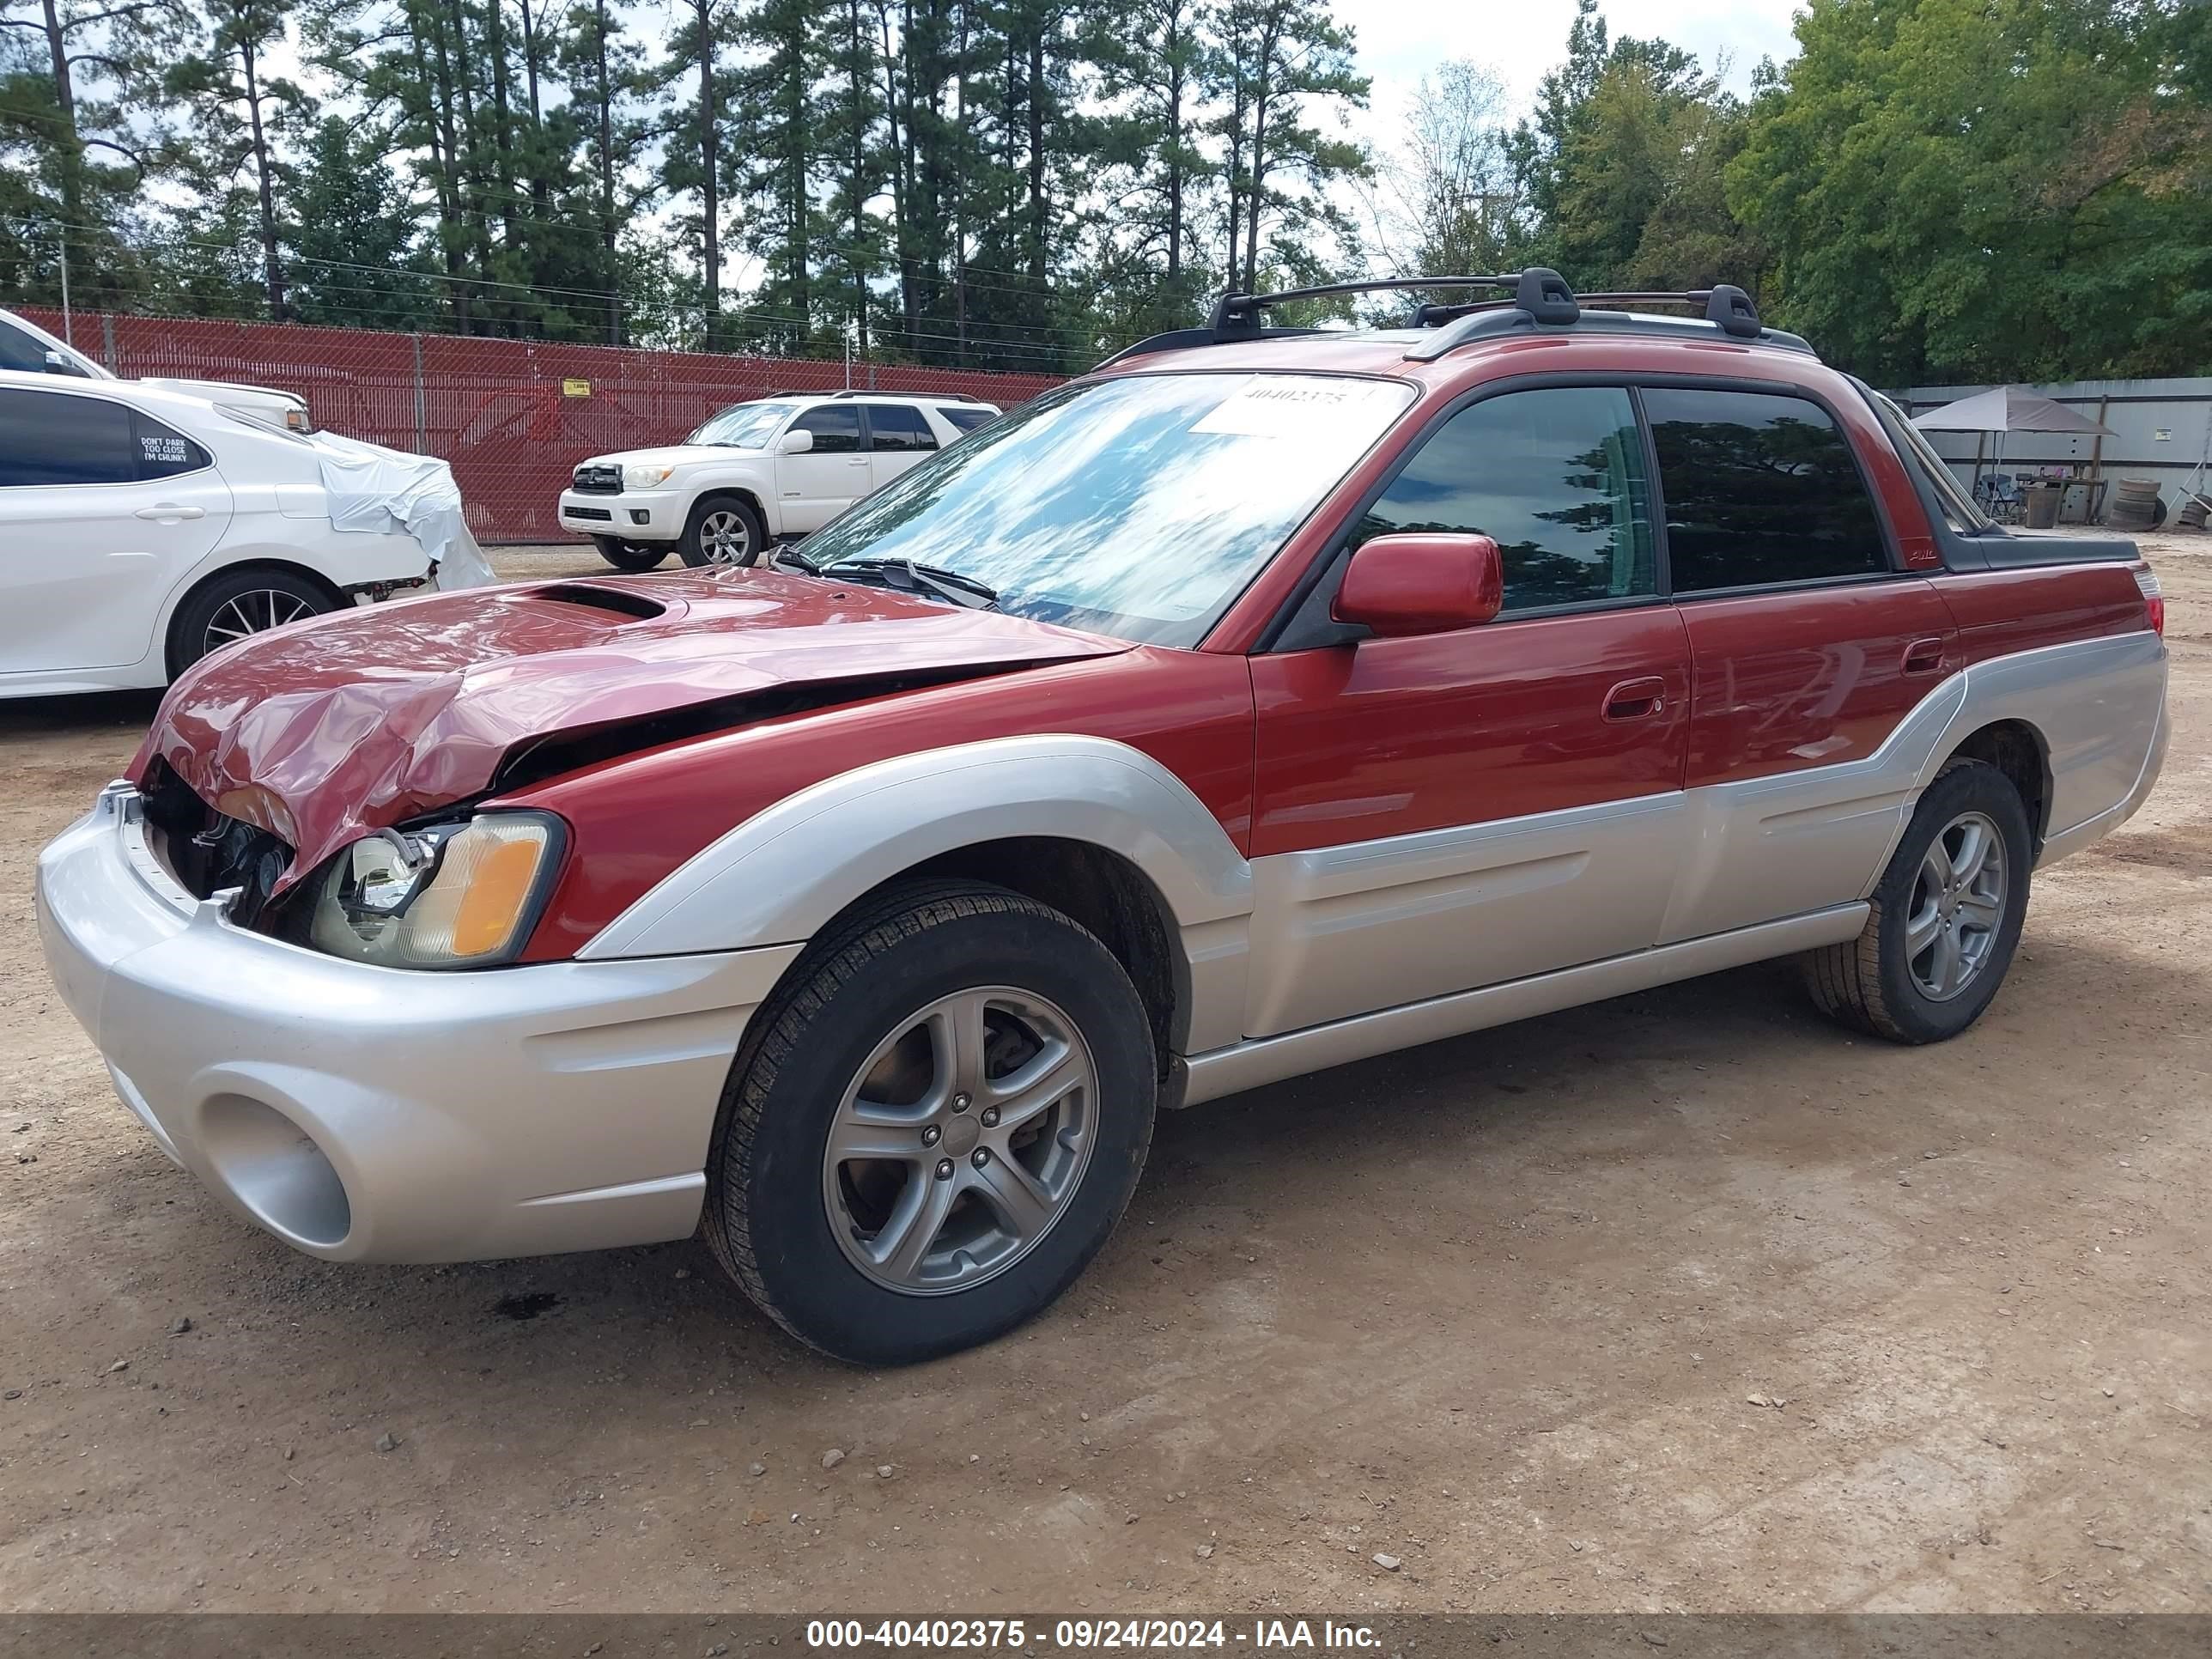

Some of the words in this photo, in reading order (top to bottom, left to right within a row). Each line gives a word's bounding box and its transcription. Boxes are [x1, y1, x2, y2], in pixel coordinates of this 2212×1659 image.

[141, 437, 163, 446] DON'T
[165, 438, 185, 447] PARK
[163, 446, 185, 454] CLOSE
[144, 453, 156, 461] I'M
[158, 453, 186, 462] CHUNKY
